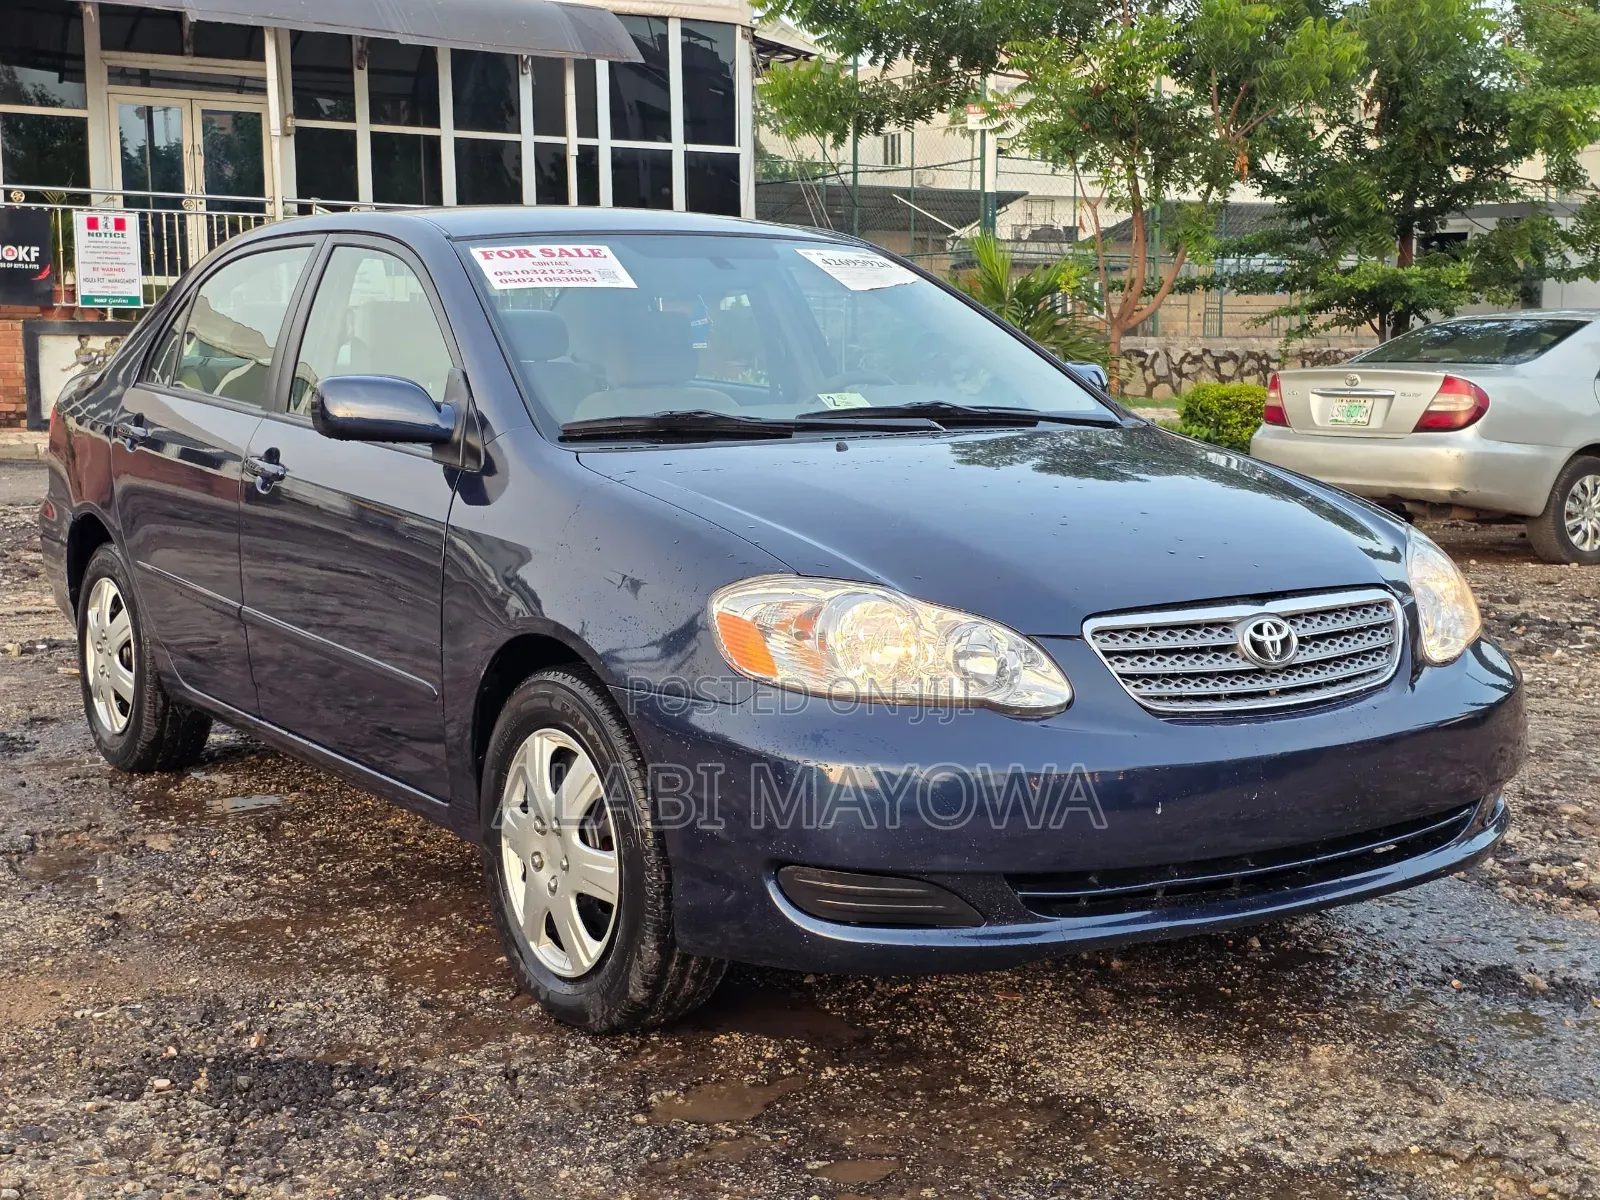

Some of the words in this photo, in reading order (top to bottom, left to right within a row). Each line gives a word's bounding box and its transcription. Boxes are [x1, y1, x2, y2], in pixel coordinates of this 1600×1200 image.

[0, 244, 40, 262] OKF
[478, 248, 536, 261] FOR
[538, 247, 608, 260] SALE
